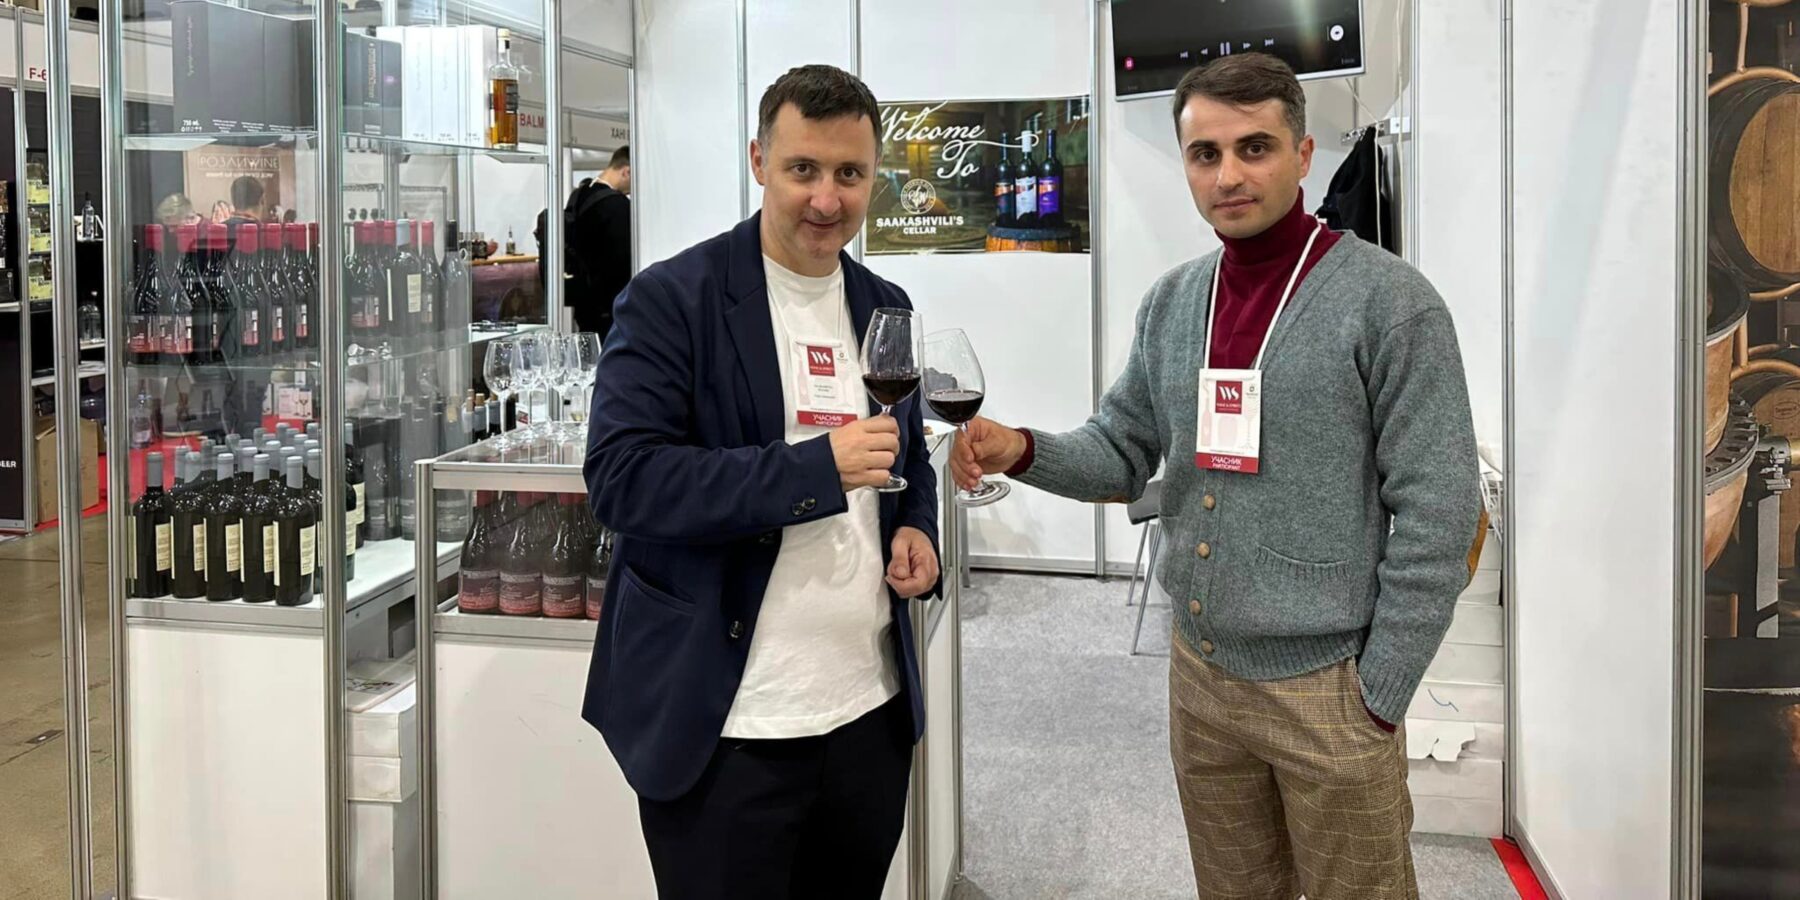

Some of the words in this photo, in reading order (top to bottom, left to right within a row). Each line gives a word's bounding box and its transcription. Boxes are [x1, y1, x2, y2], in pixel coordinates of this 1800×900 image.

[520, 113, 544, 128] BALM
[881, 100, 985, 143] Welcome
[876, 215, 964, 227] SAAKASHVILI'S
[903, 226, 937, 234] CELLAR
[0, 460, 17, 468] EER
[1211, 455, 1242, 466] УЧАСНИК
